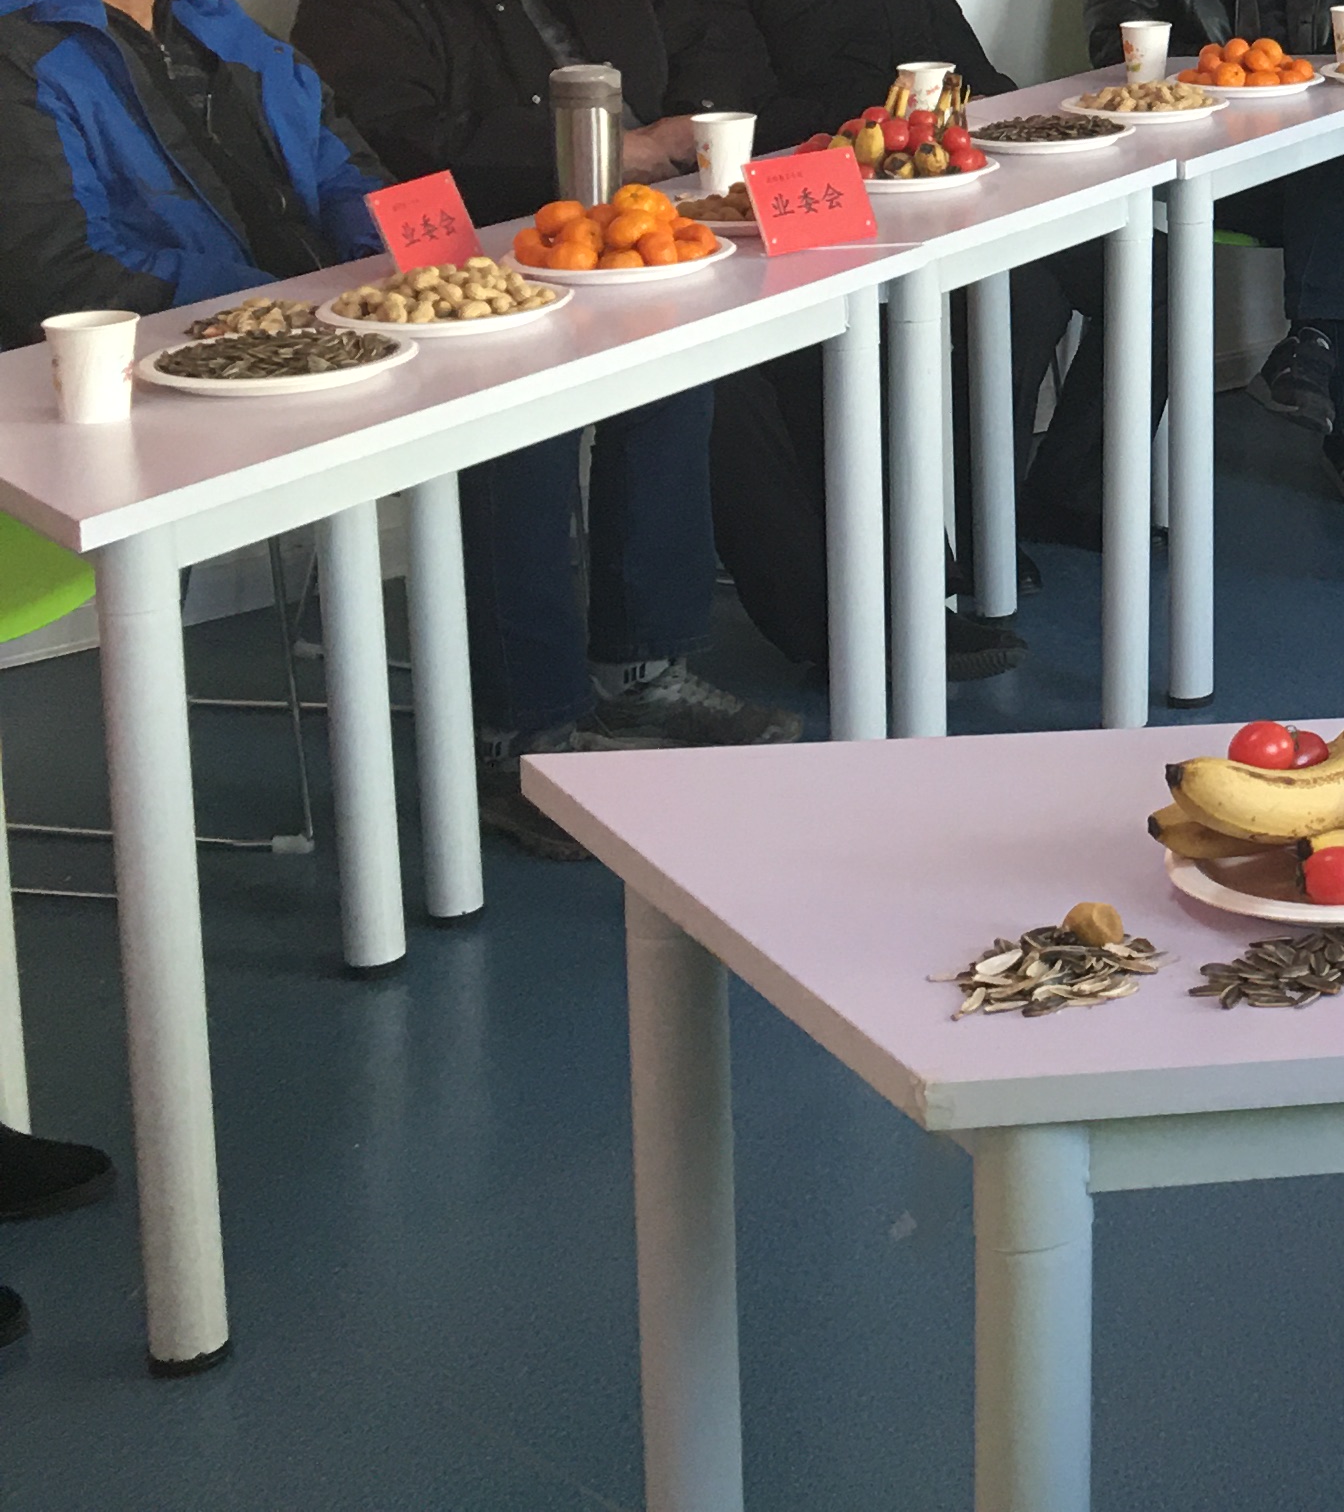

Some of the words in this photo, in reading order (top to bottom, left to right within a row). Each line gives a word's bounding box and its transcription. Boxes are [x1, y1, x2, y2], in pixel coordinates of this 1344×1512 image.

[771, 183, 844, 218] 业委会
[401, 209, 457, 248] 业委会
